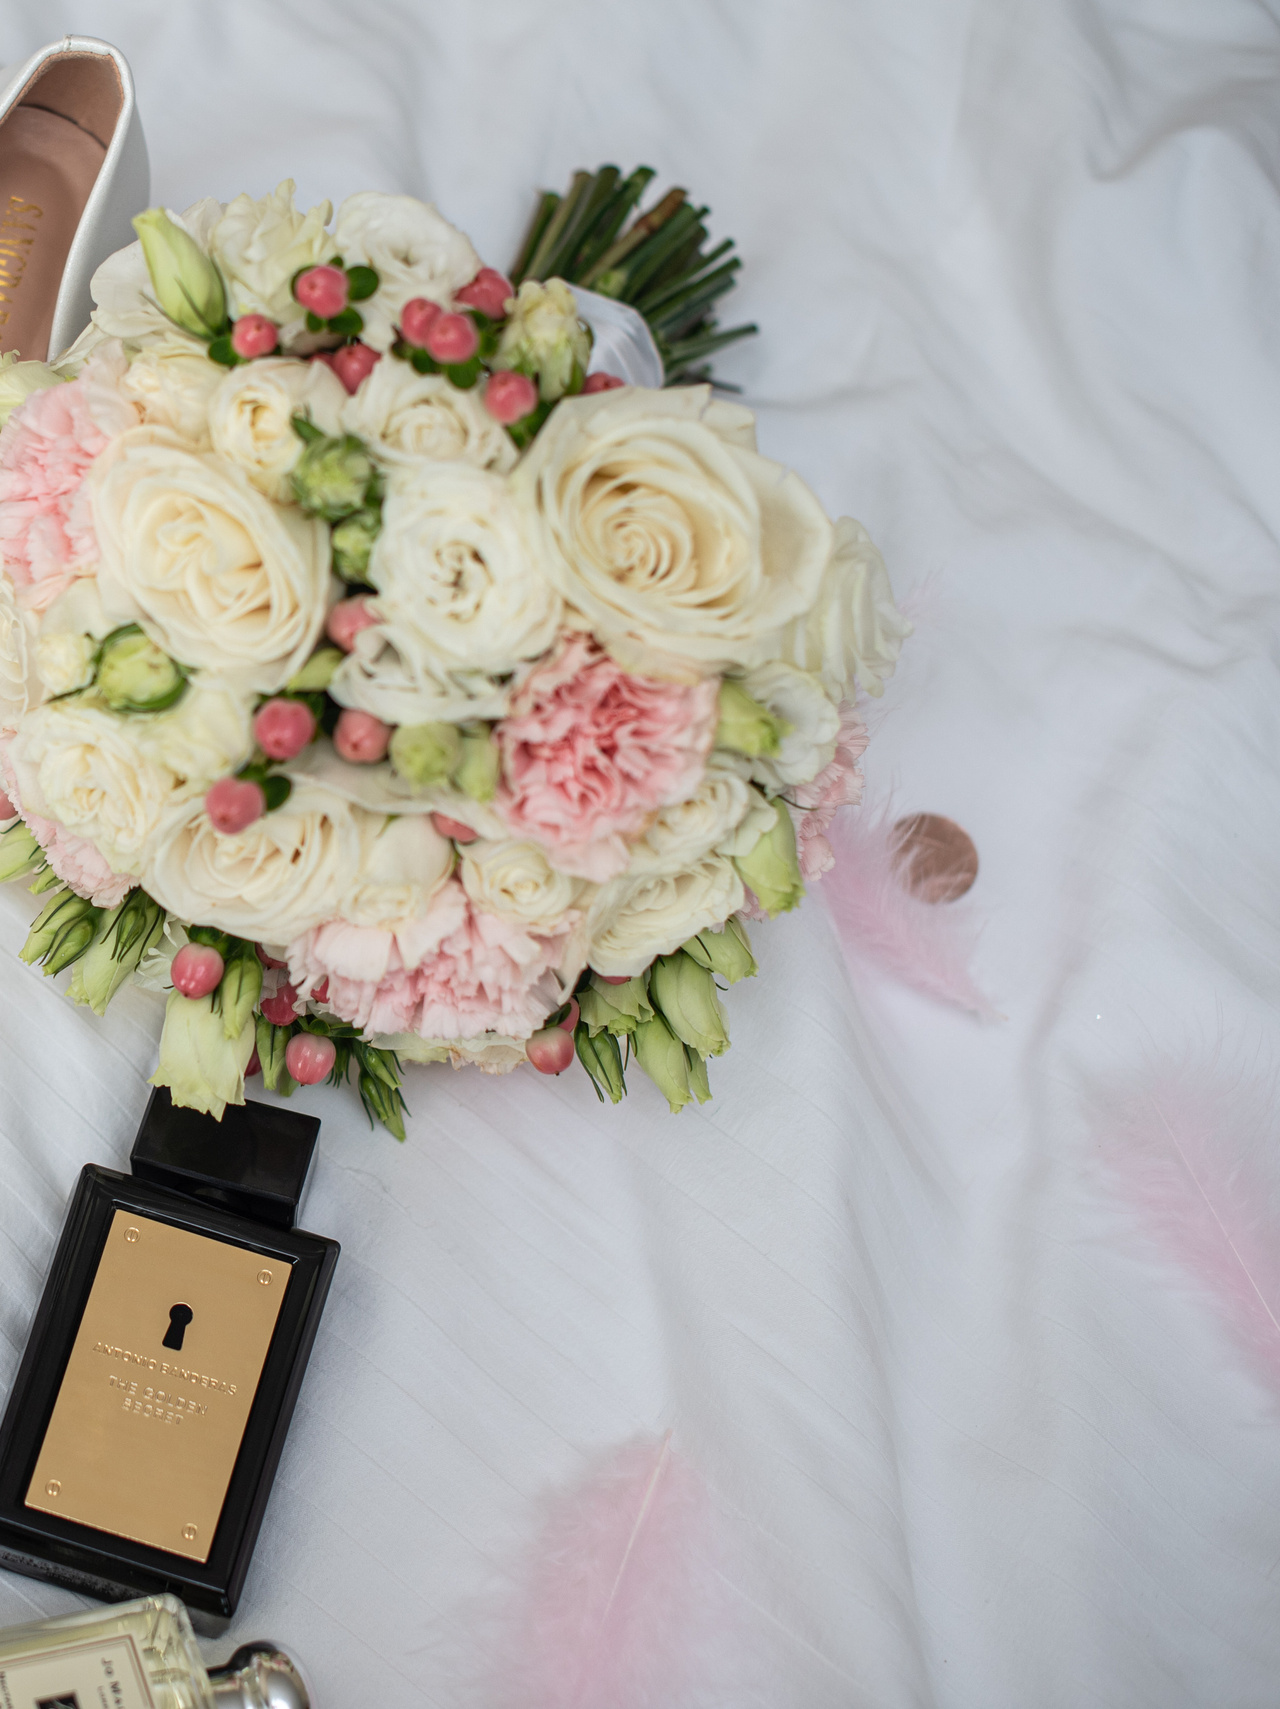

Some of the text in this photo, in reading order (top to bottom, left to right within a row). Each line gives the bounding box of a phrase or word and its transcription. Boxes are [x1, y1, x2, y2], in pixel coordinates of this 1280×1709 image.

[92, 1341, 238, 1396] ANTONIO BANDERAS
[109, 1375, 209, 1416] THE GOLDEN
[121, 1397, 184, 1425] SECRET
